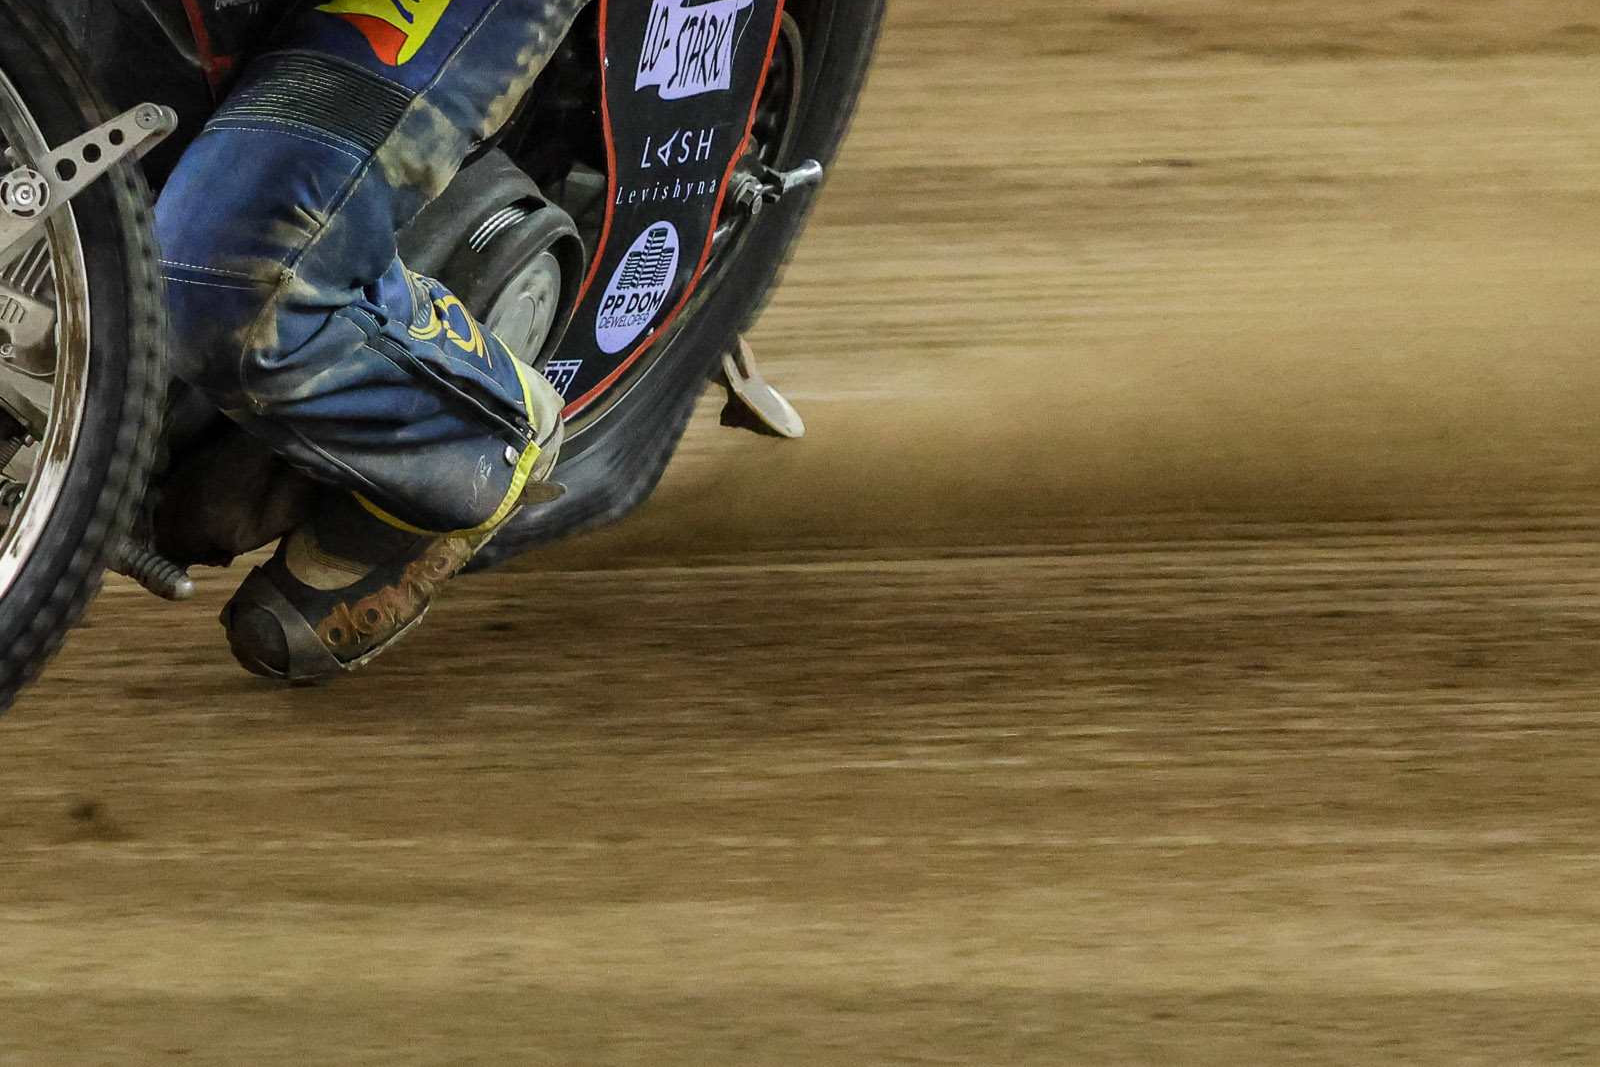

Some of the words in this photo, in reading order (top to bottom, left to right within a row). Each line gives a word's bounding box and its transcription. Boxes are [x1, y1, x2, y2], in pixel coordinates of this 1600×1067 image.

[616, 178, 717, 205] Levishyna
[600, 294, 624, 317] PP
[627, 289, 667, 314] DOM
[598, 313, 650, 330] DEWELOPER
